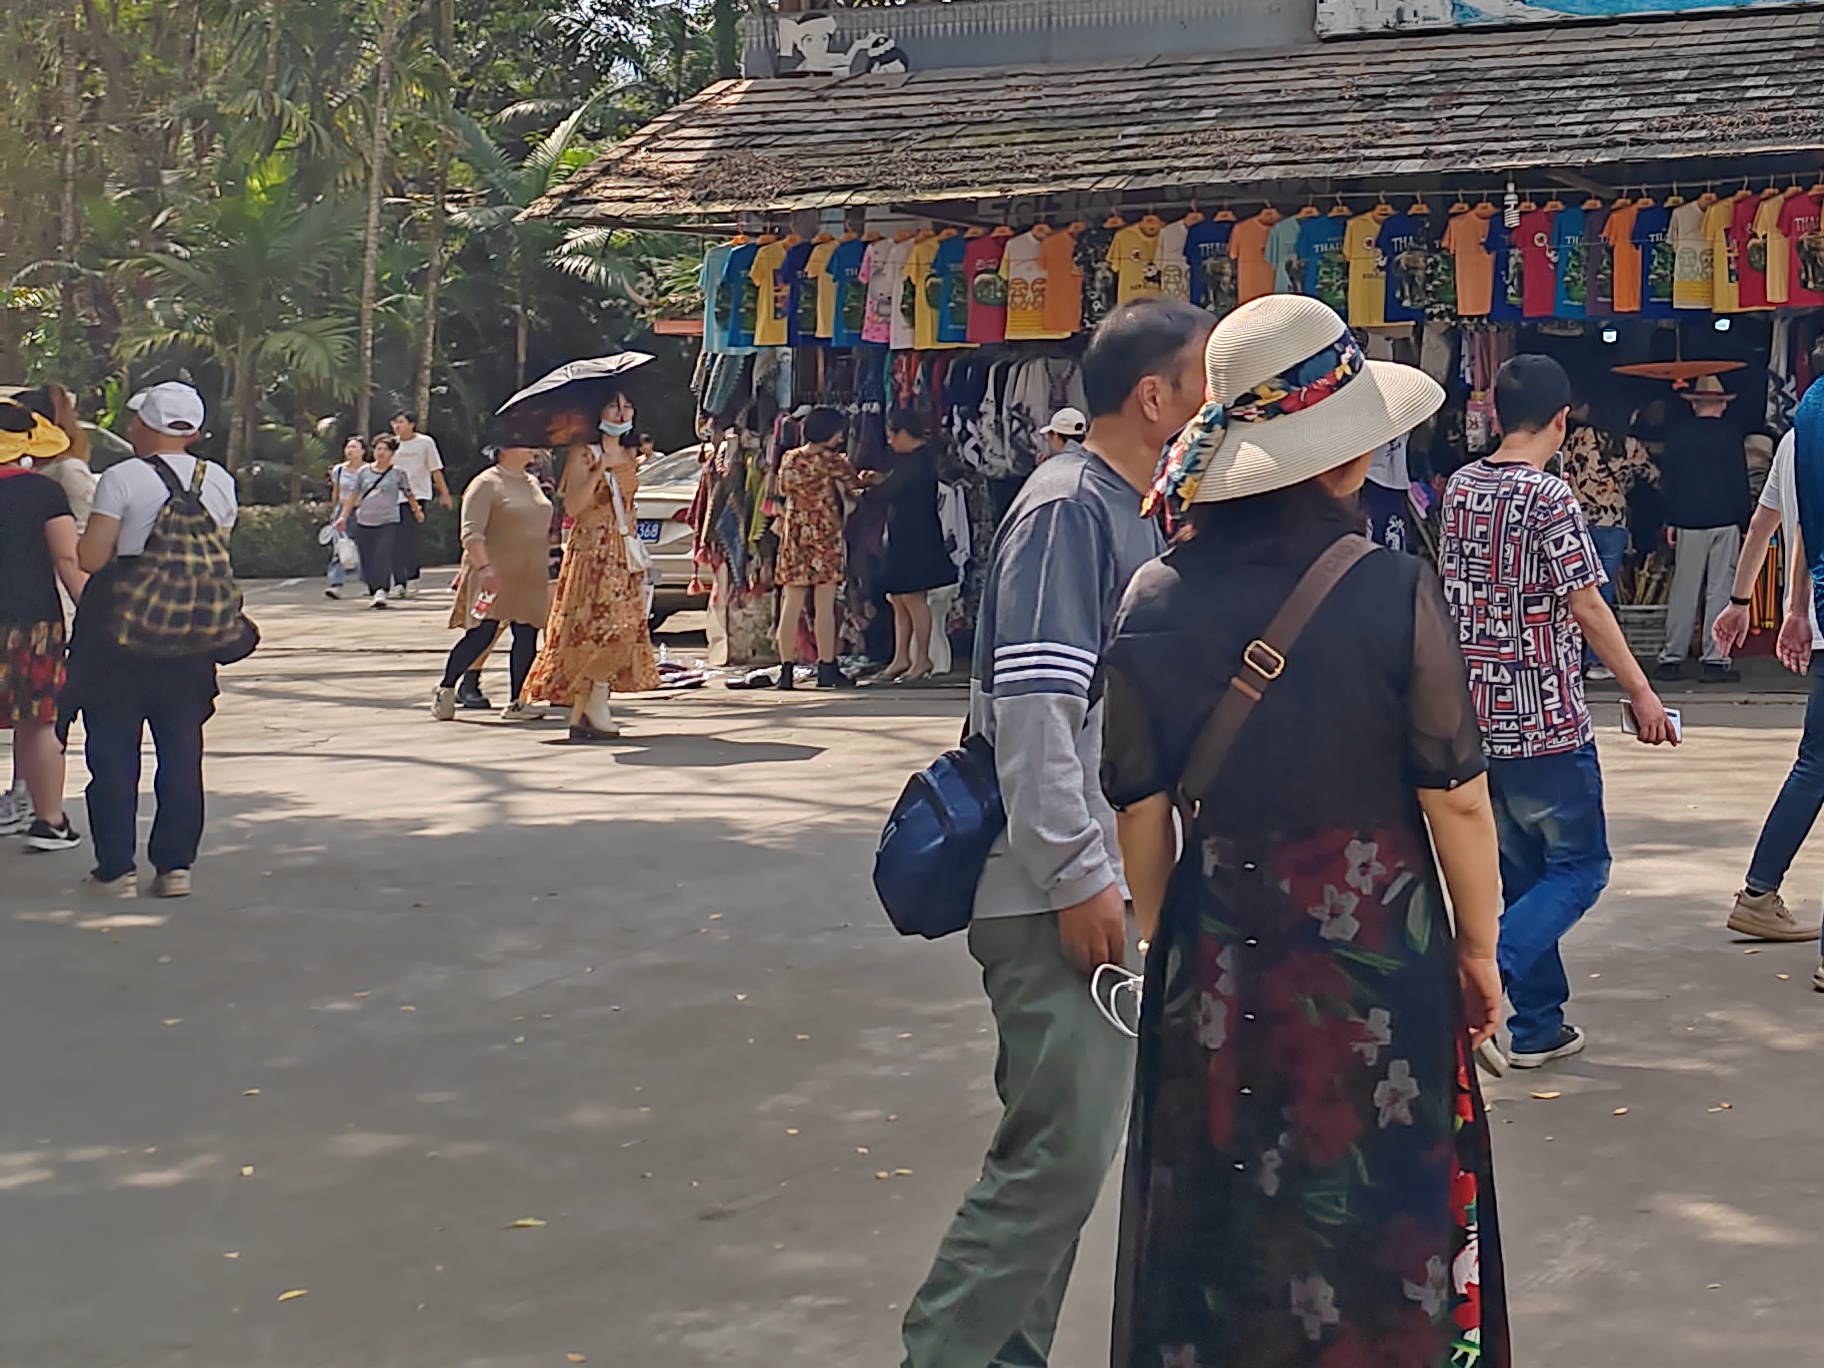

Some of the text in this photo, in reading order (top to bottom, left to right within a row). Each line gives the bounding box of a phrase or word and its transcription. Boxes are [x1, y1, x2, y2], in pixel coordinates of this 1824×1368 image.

[1502, 466, 1542, 484] FILA
[1453, 489, 1493, 512] FILA
[1469, 662, 1512, 685] FILA
[1491, 720, 1519, 731] FILA
